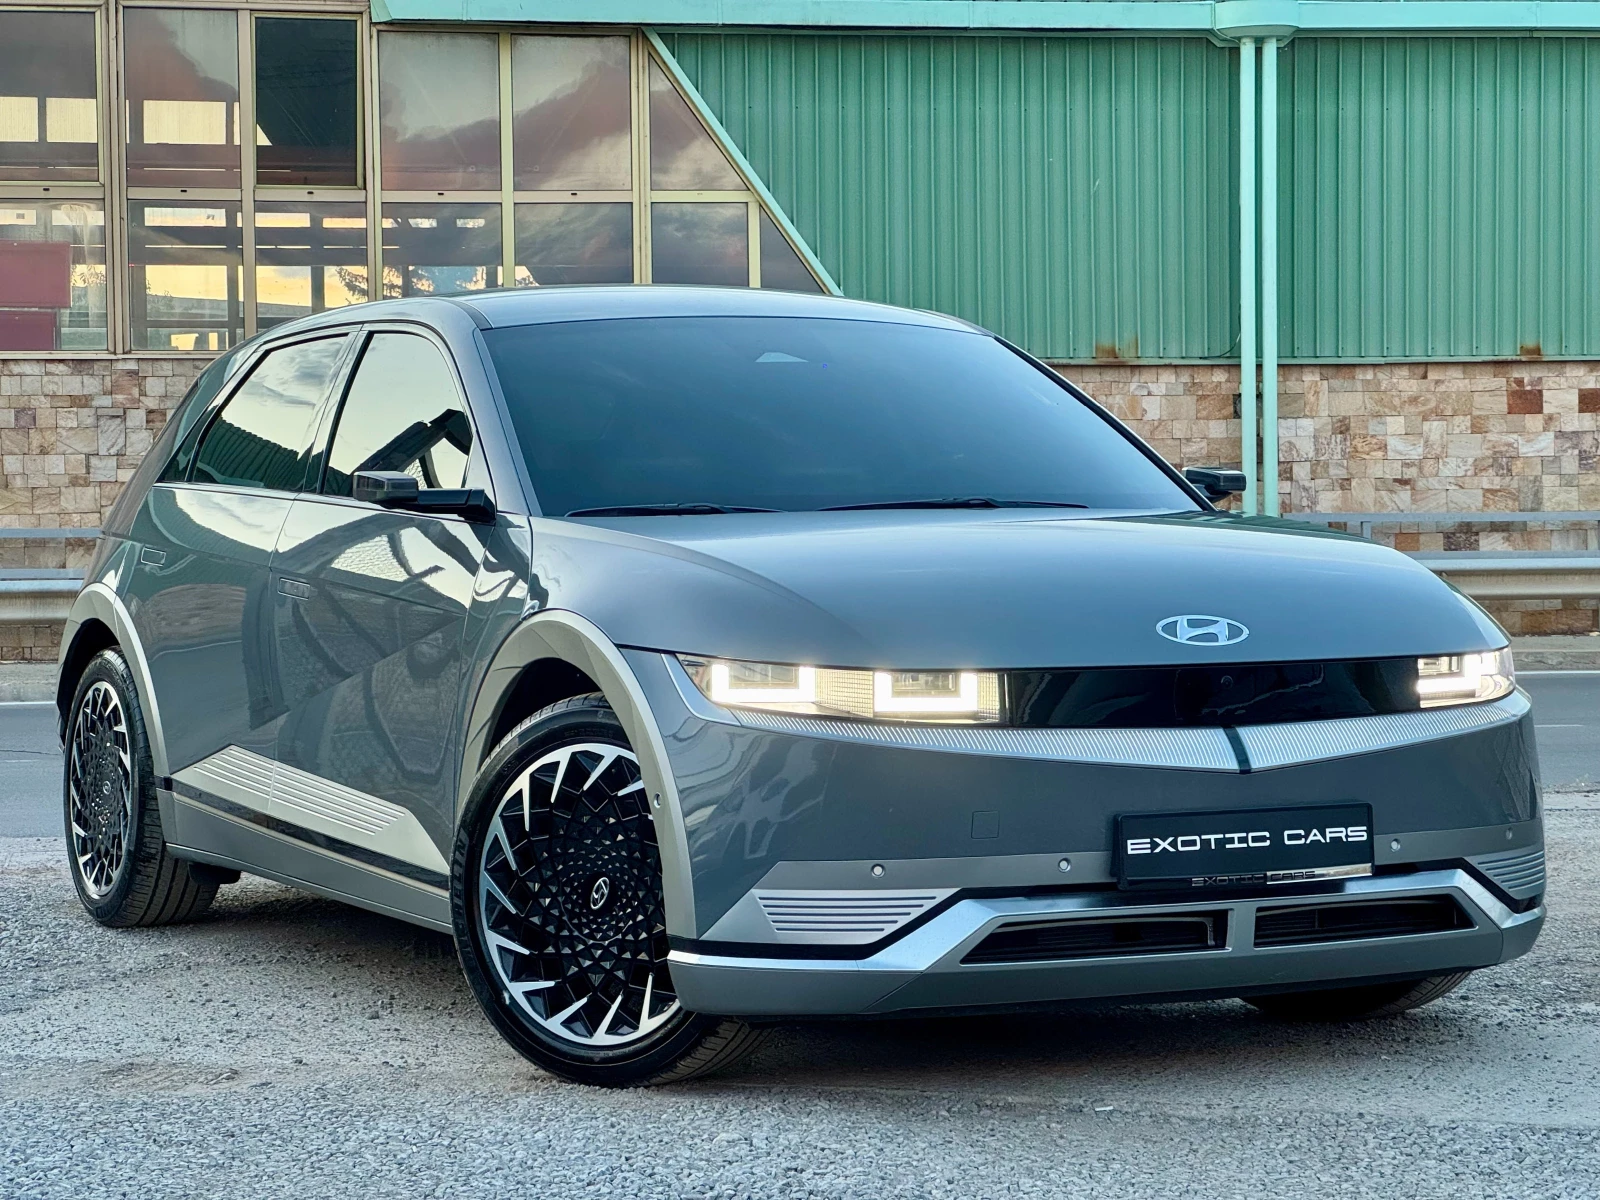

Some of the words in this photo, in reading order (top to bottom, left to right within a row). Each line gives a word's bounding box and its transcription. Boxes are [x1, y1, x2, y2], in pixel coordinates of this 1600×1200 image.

[1126, 831, 1271, 855] EXOTIC
[1283, 826, 1368, 846] CARS
[1191, 874, 1265, 887] EXOTIC
[1270, 870, 1316, 882] CARS
